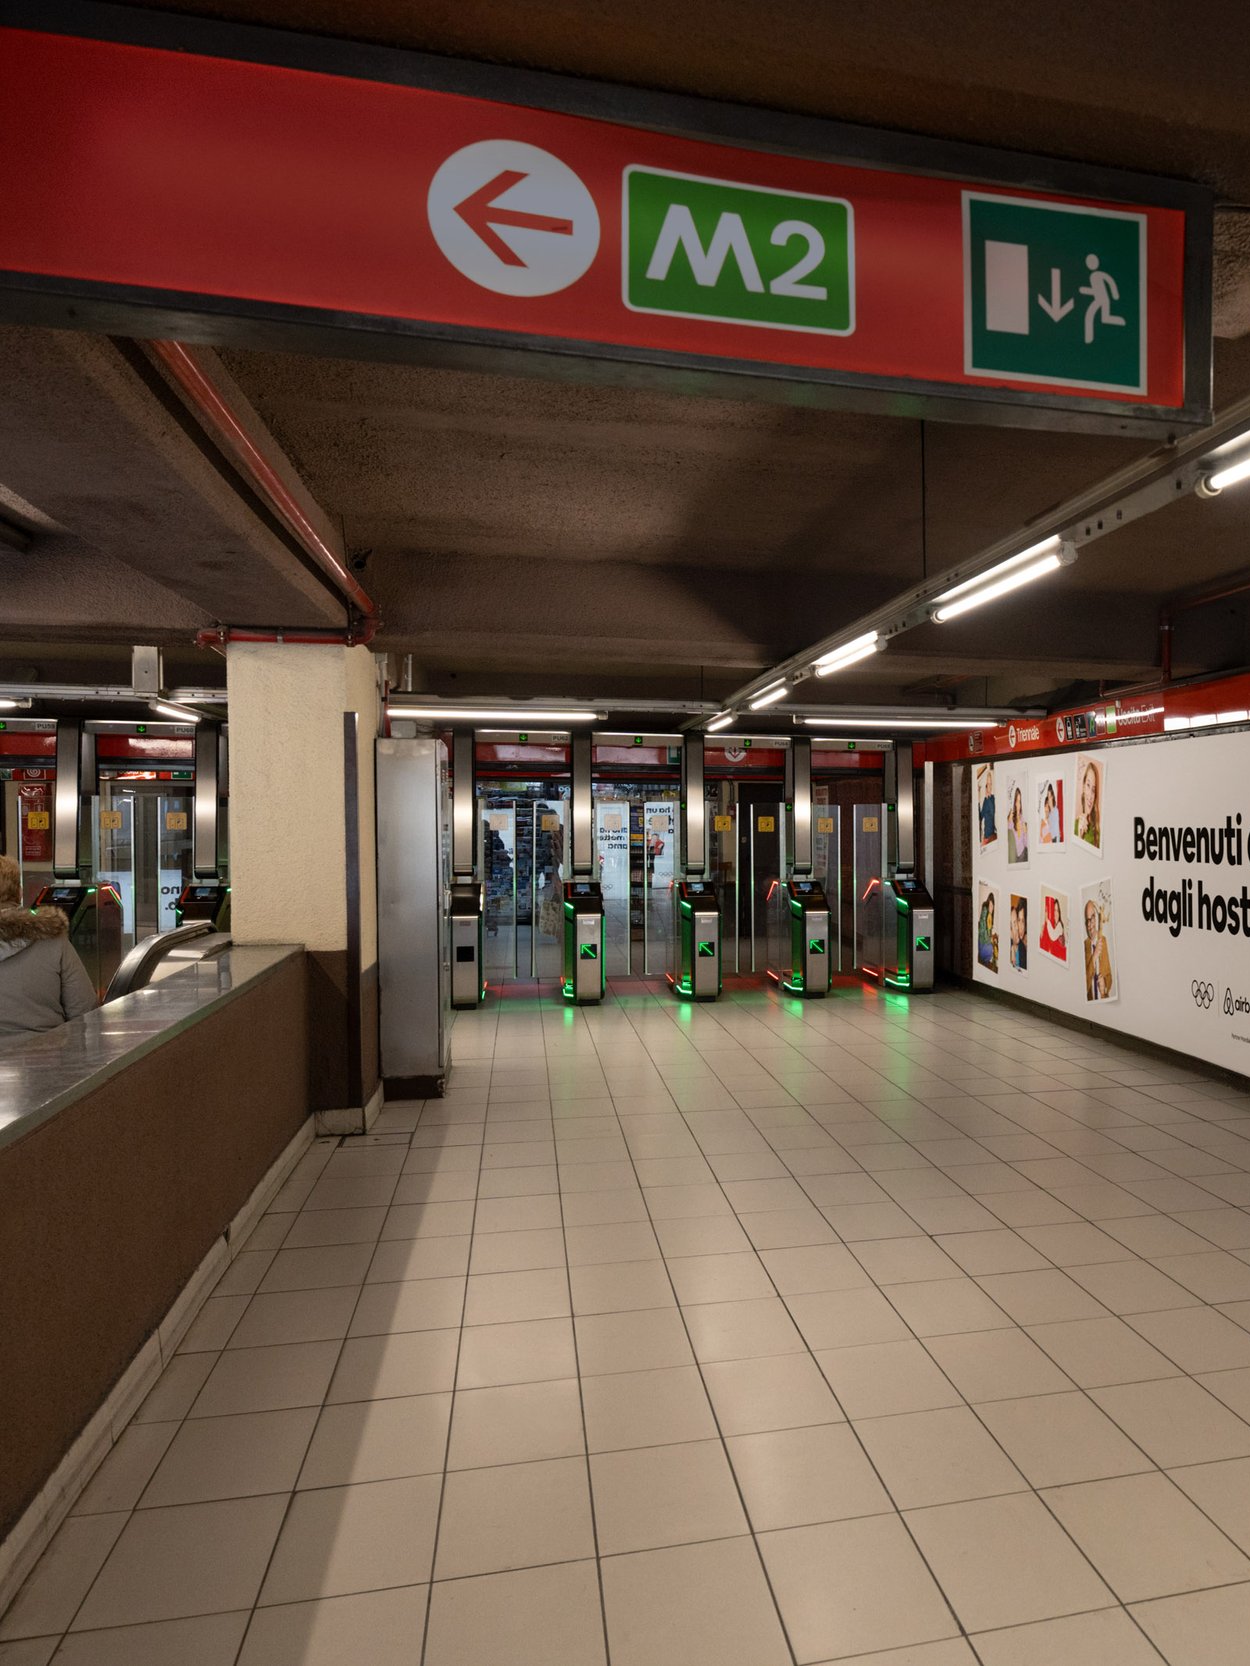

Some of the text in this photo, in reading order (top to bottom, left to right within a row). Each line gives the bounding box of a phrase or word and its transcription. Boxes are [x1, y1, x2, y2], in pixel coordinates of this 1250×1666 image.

[646, 203, 828, 301] M2
[1016, 725, 1040, 742] Triennale
[1133, 812, 1242, 866] Benvenuti
[1141, 876, 1193, 938] dagli
